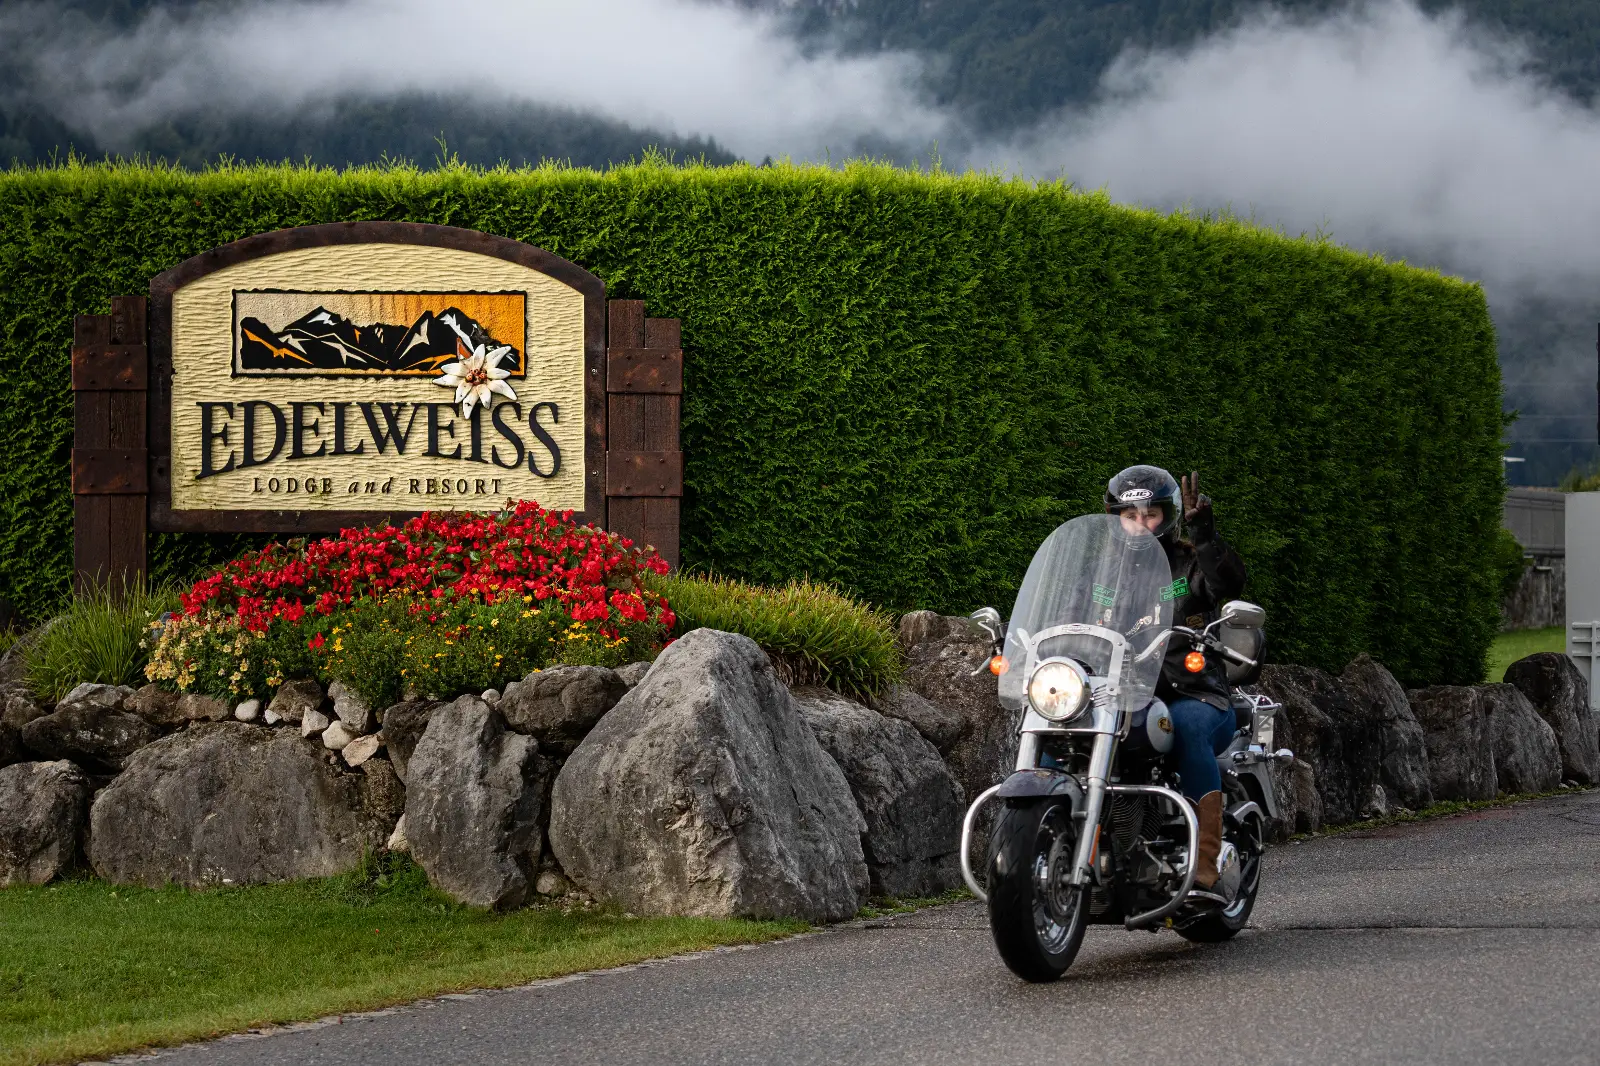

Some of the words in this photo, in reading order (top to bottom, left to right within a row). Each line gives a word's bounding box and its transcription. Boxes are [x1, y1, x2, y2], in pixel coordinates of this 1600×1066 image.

[195, 400, 562, 478] EDELWEISS
[252, 477, 334, 494] LODGE
[348, 476, 394, 494] and
[408, 478, 502, 494] RESORT
